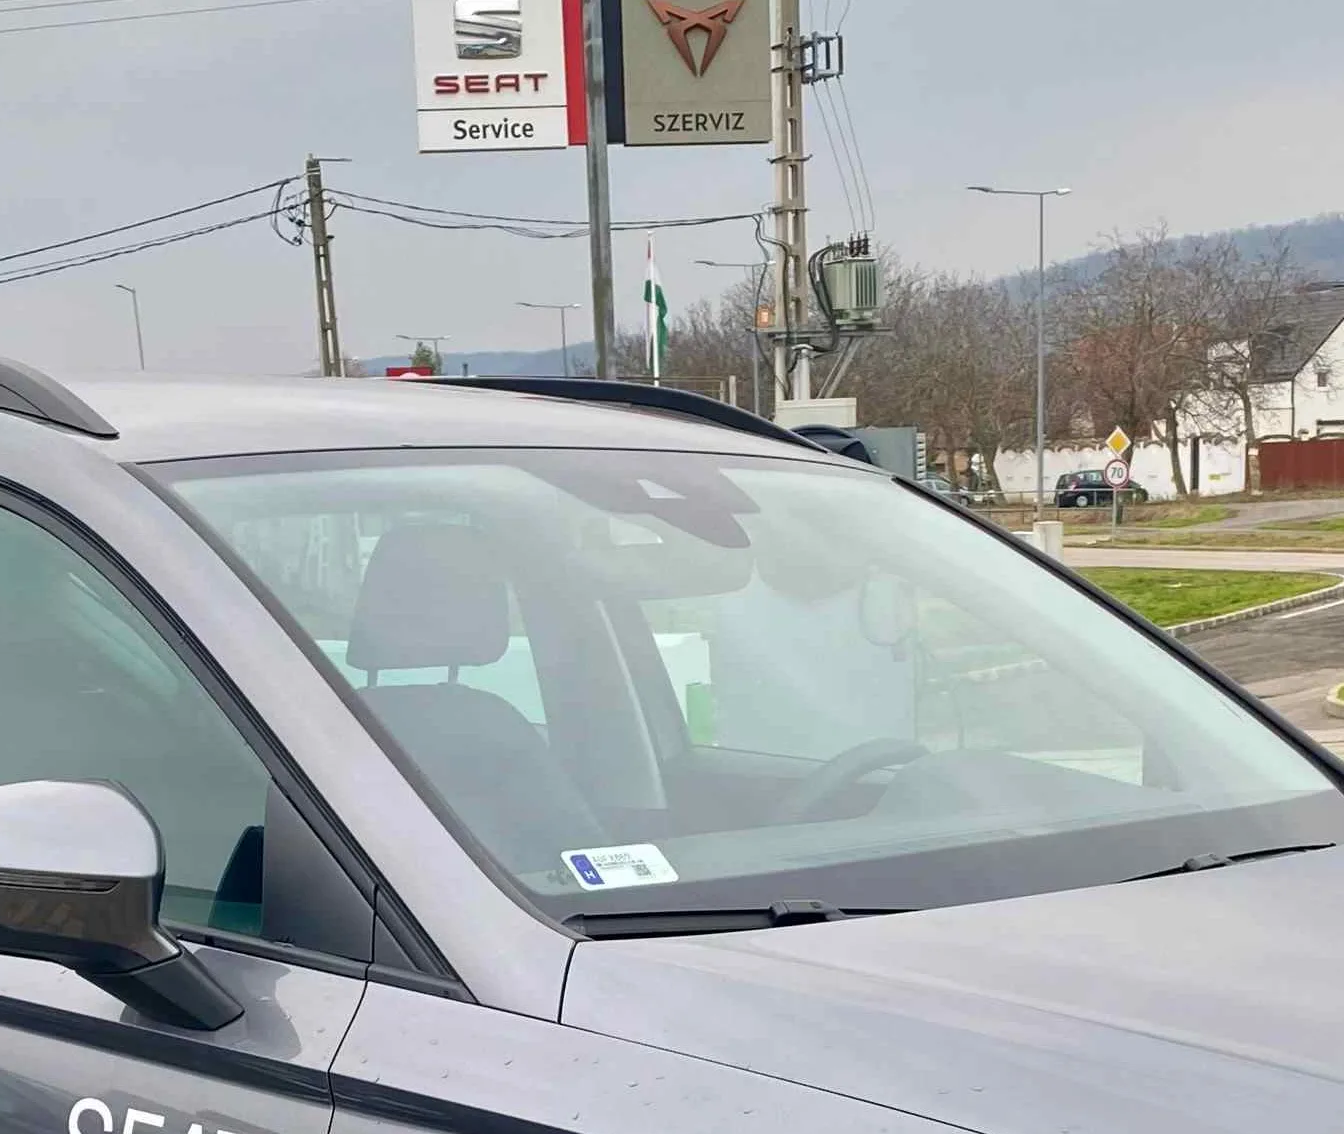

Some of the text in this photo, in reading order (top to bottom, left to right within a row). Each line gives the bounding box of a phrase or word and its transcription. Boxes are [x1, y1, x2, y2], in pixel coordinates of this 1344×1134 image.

[434, 73, 548, 95] SEAT
[453, 117, 535, 140] Service
[654, 112, 745, 132] SZERVIZ
[1111, 467, 1123, 478] 70
